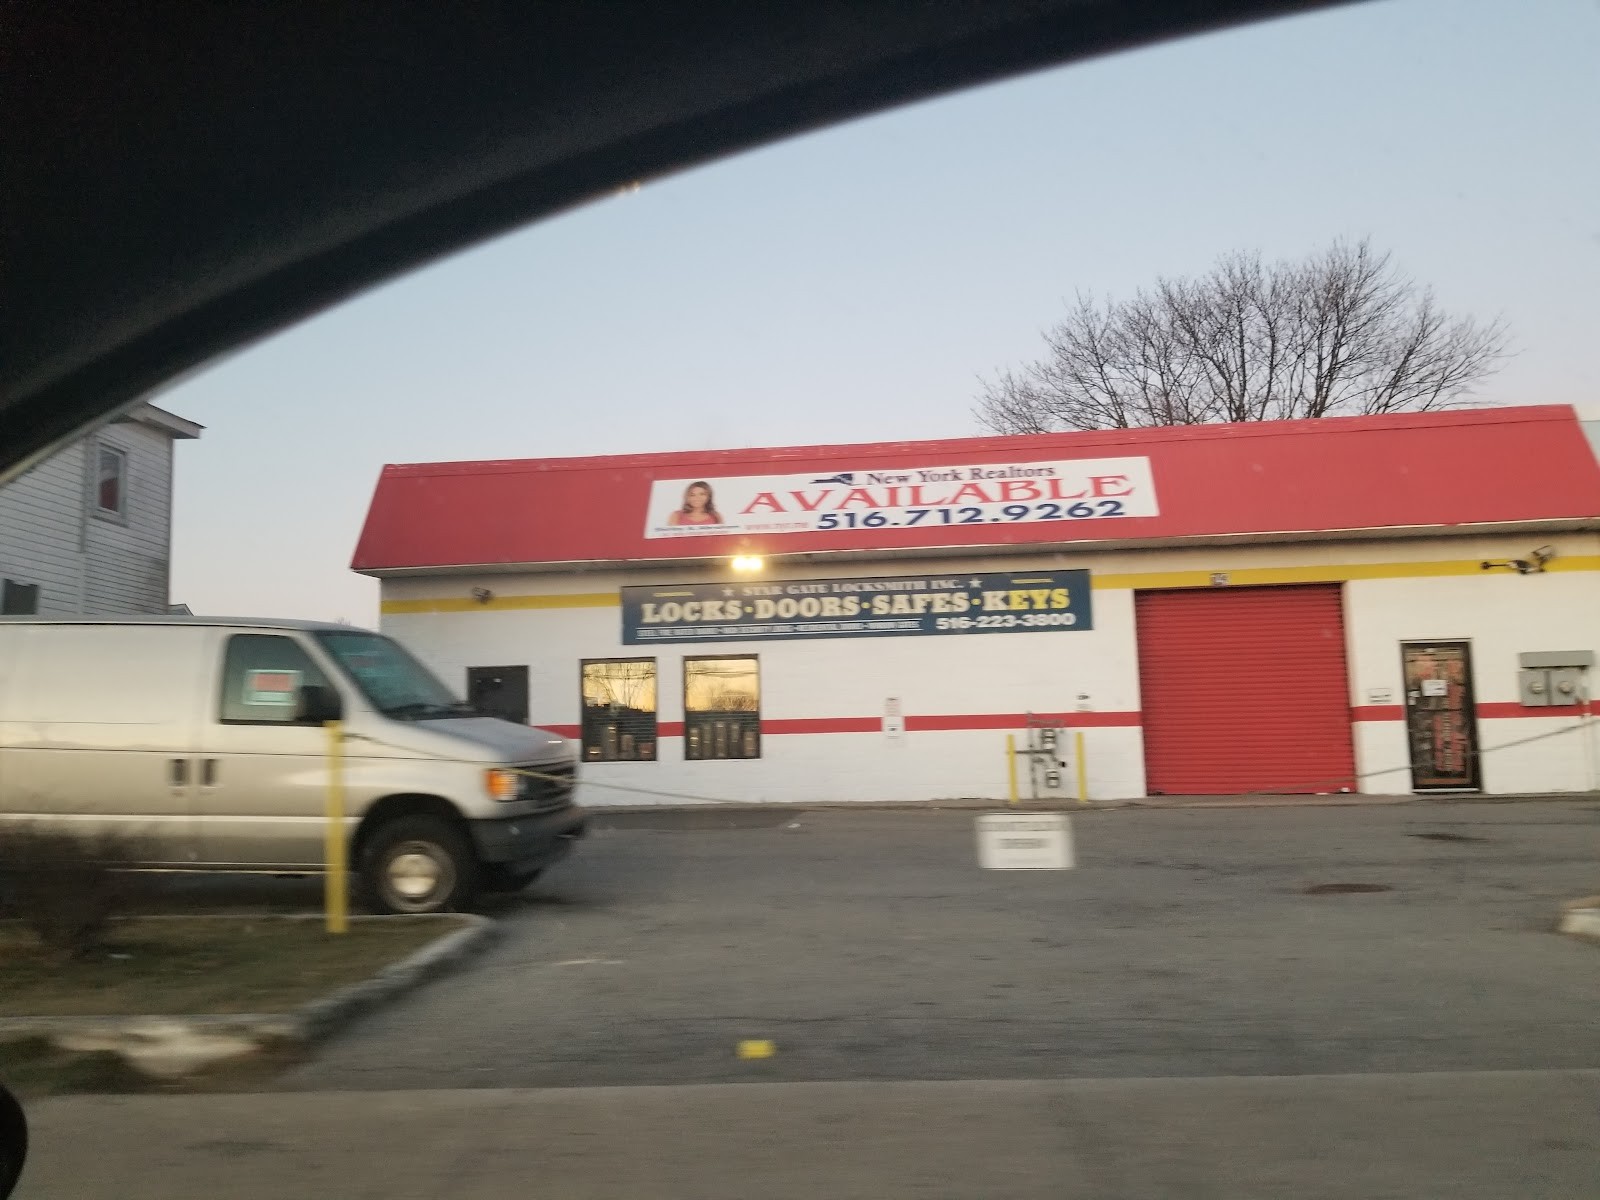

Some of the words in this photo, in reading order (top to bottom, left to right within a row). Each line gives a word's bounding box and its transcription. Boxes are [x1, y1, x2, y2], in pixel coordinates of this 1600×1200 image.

[867, 473, 910, 485] New
[917, 470, 963, 483] York
[969, 466, 1055, 480] Realtors
[738, 475, 1135, 514] AVAILABLE
[816, 500, 1125, 530] 516.712.9262
[786, 583, 829, 595] GATE
[832, 580, 927, 593] LOCKSMITH
[930, 579, 965, 589] INC.
[641, 601, 743, 623] LOCKS
[754, 596, 859, 619] DOORS
[872, 592, 969, 614] SAFES
[982, 588, 1070, 611] KEYS
